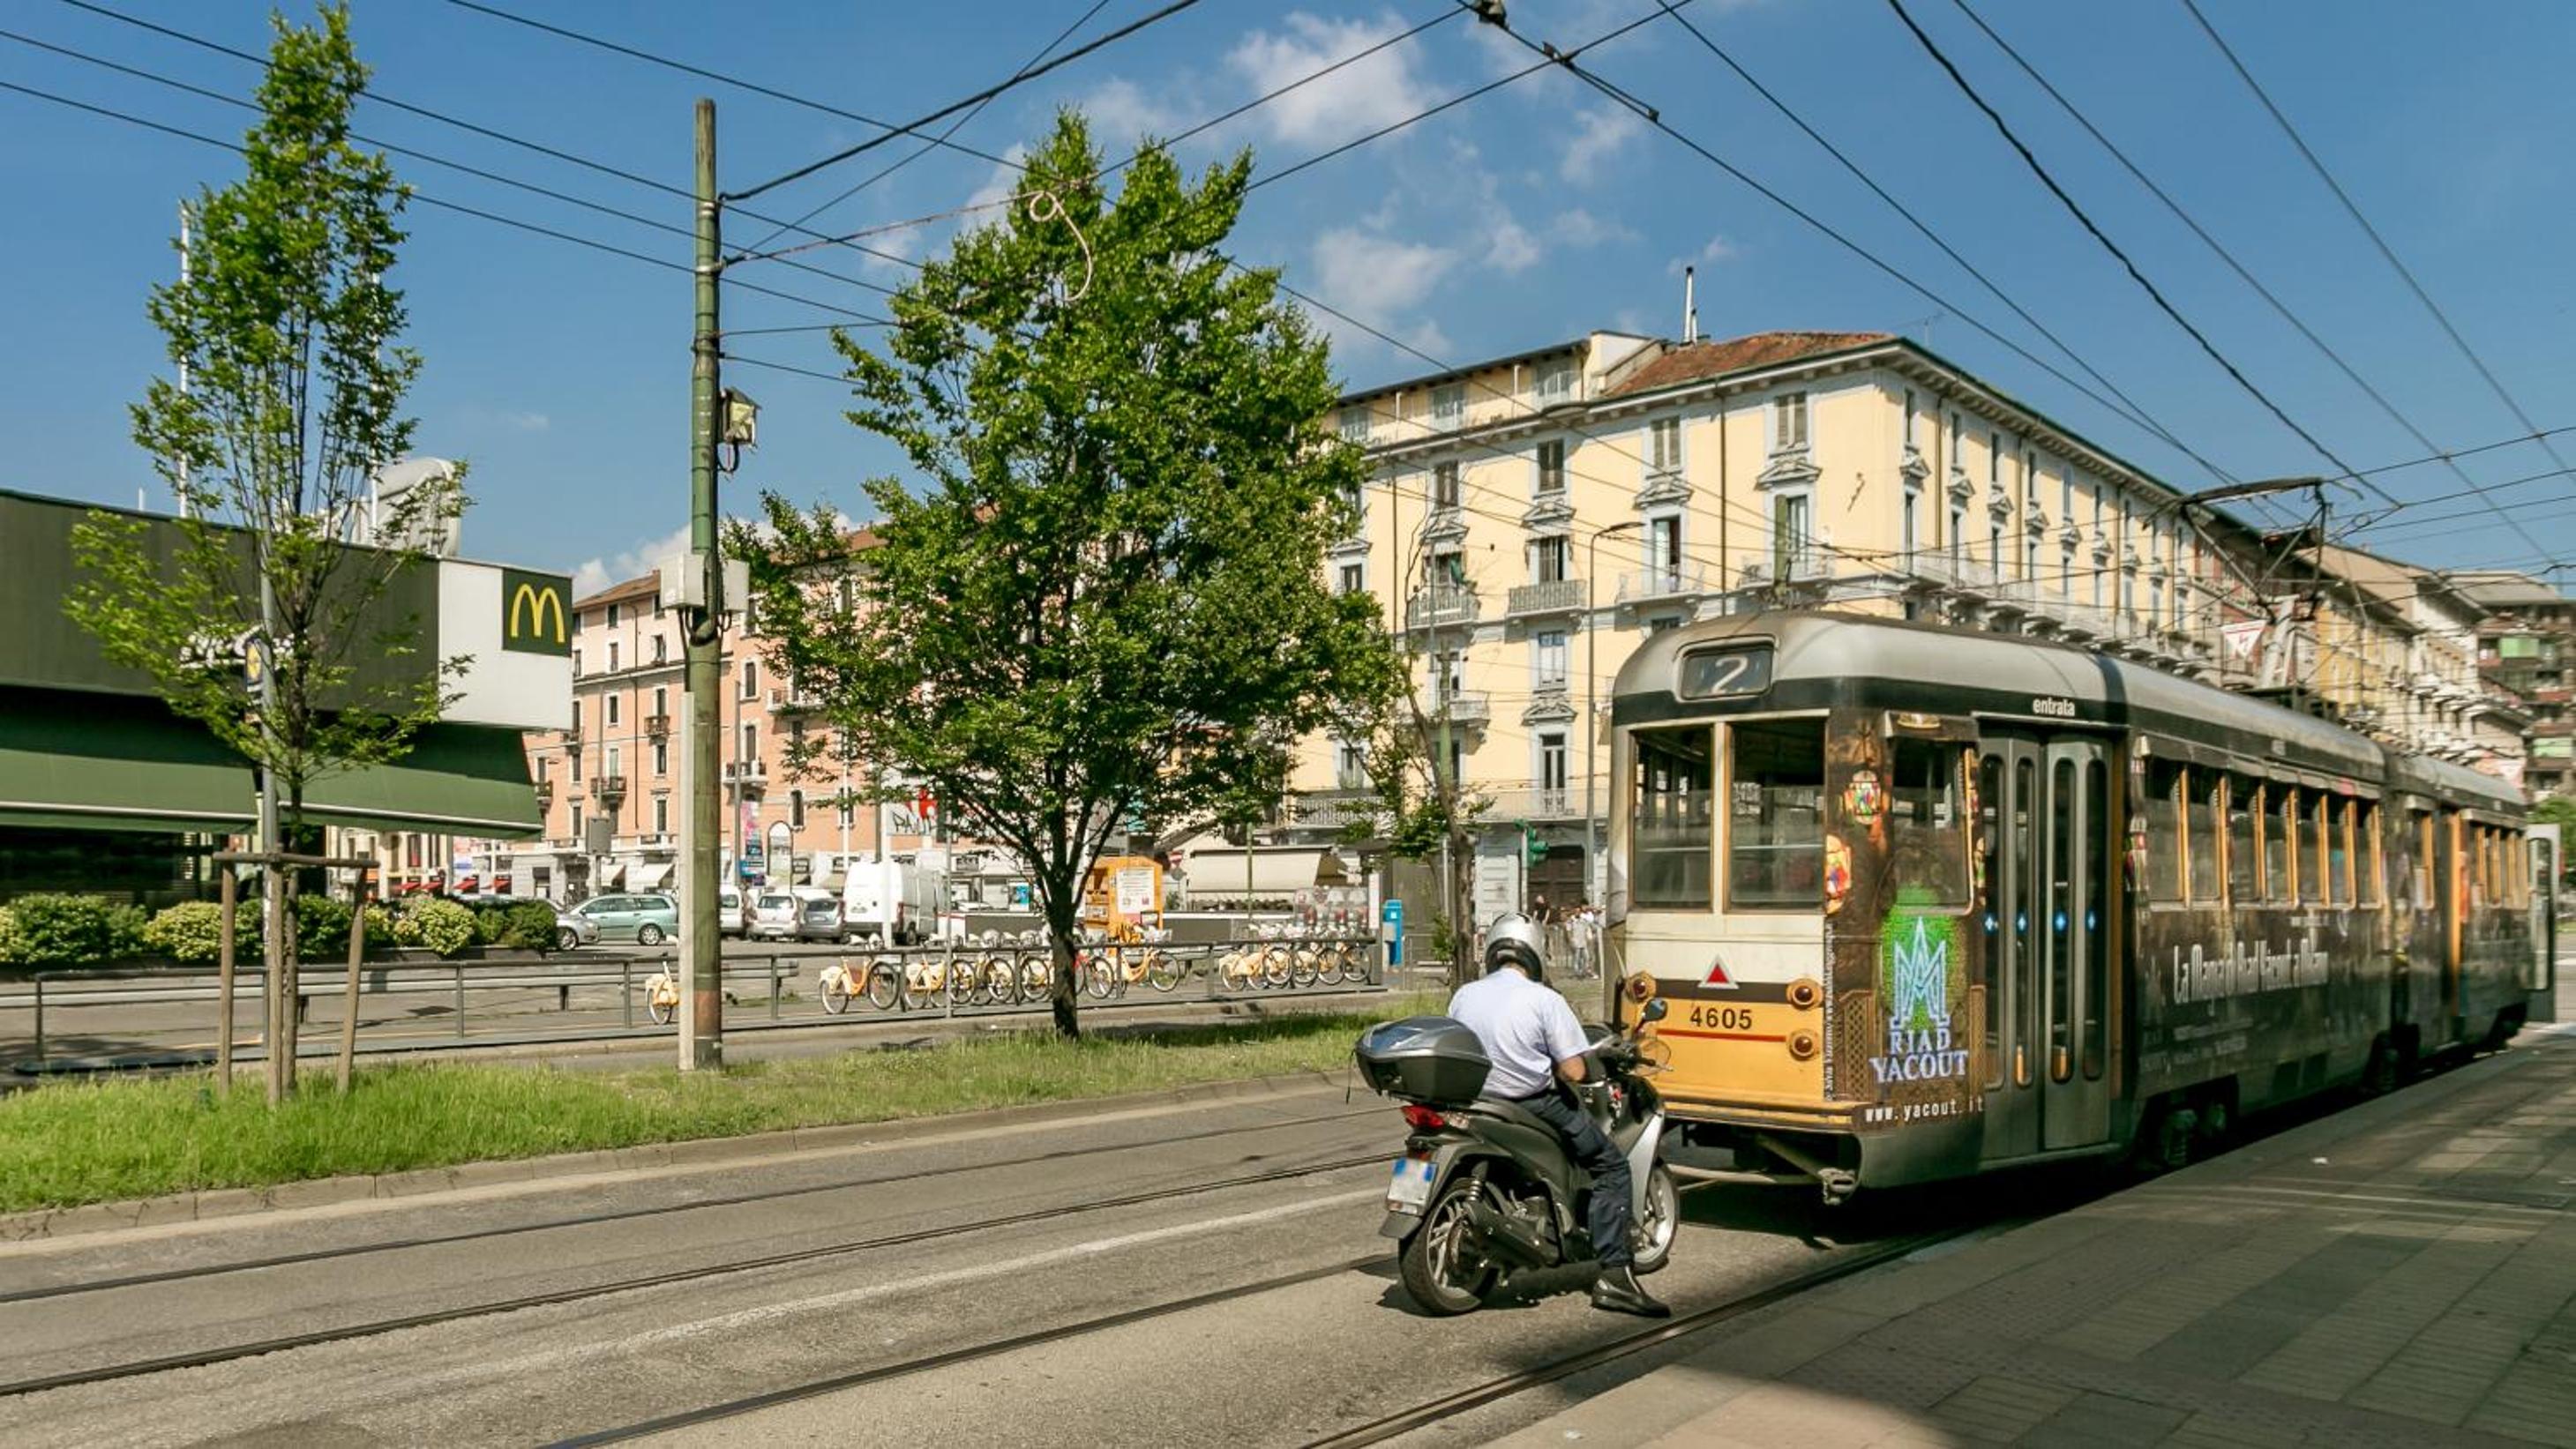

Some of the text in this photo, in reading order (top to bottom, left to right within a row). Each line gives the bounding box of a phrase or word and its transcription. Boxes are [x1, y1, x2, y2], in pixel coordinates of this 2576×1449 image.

[511, 583, 565, 643] M
[2033, 697, 2075, 717] entrata
[2174, 945, 2189, 1005] La
[1689, 1006, 1753, 1030] 4605
[1890, 1027, 1952, 1055] RIAD
[1868, 1049, 1969, 1084] YACOUT
[1865, 1095, 1983, 1123] www.yacout.it
